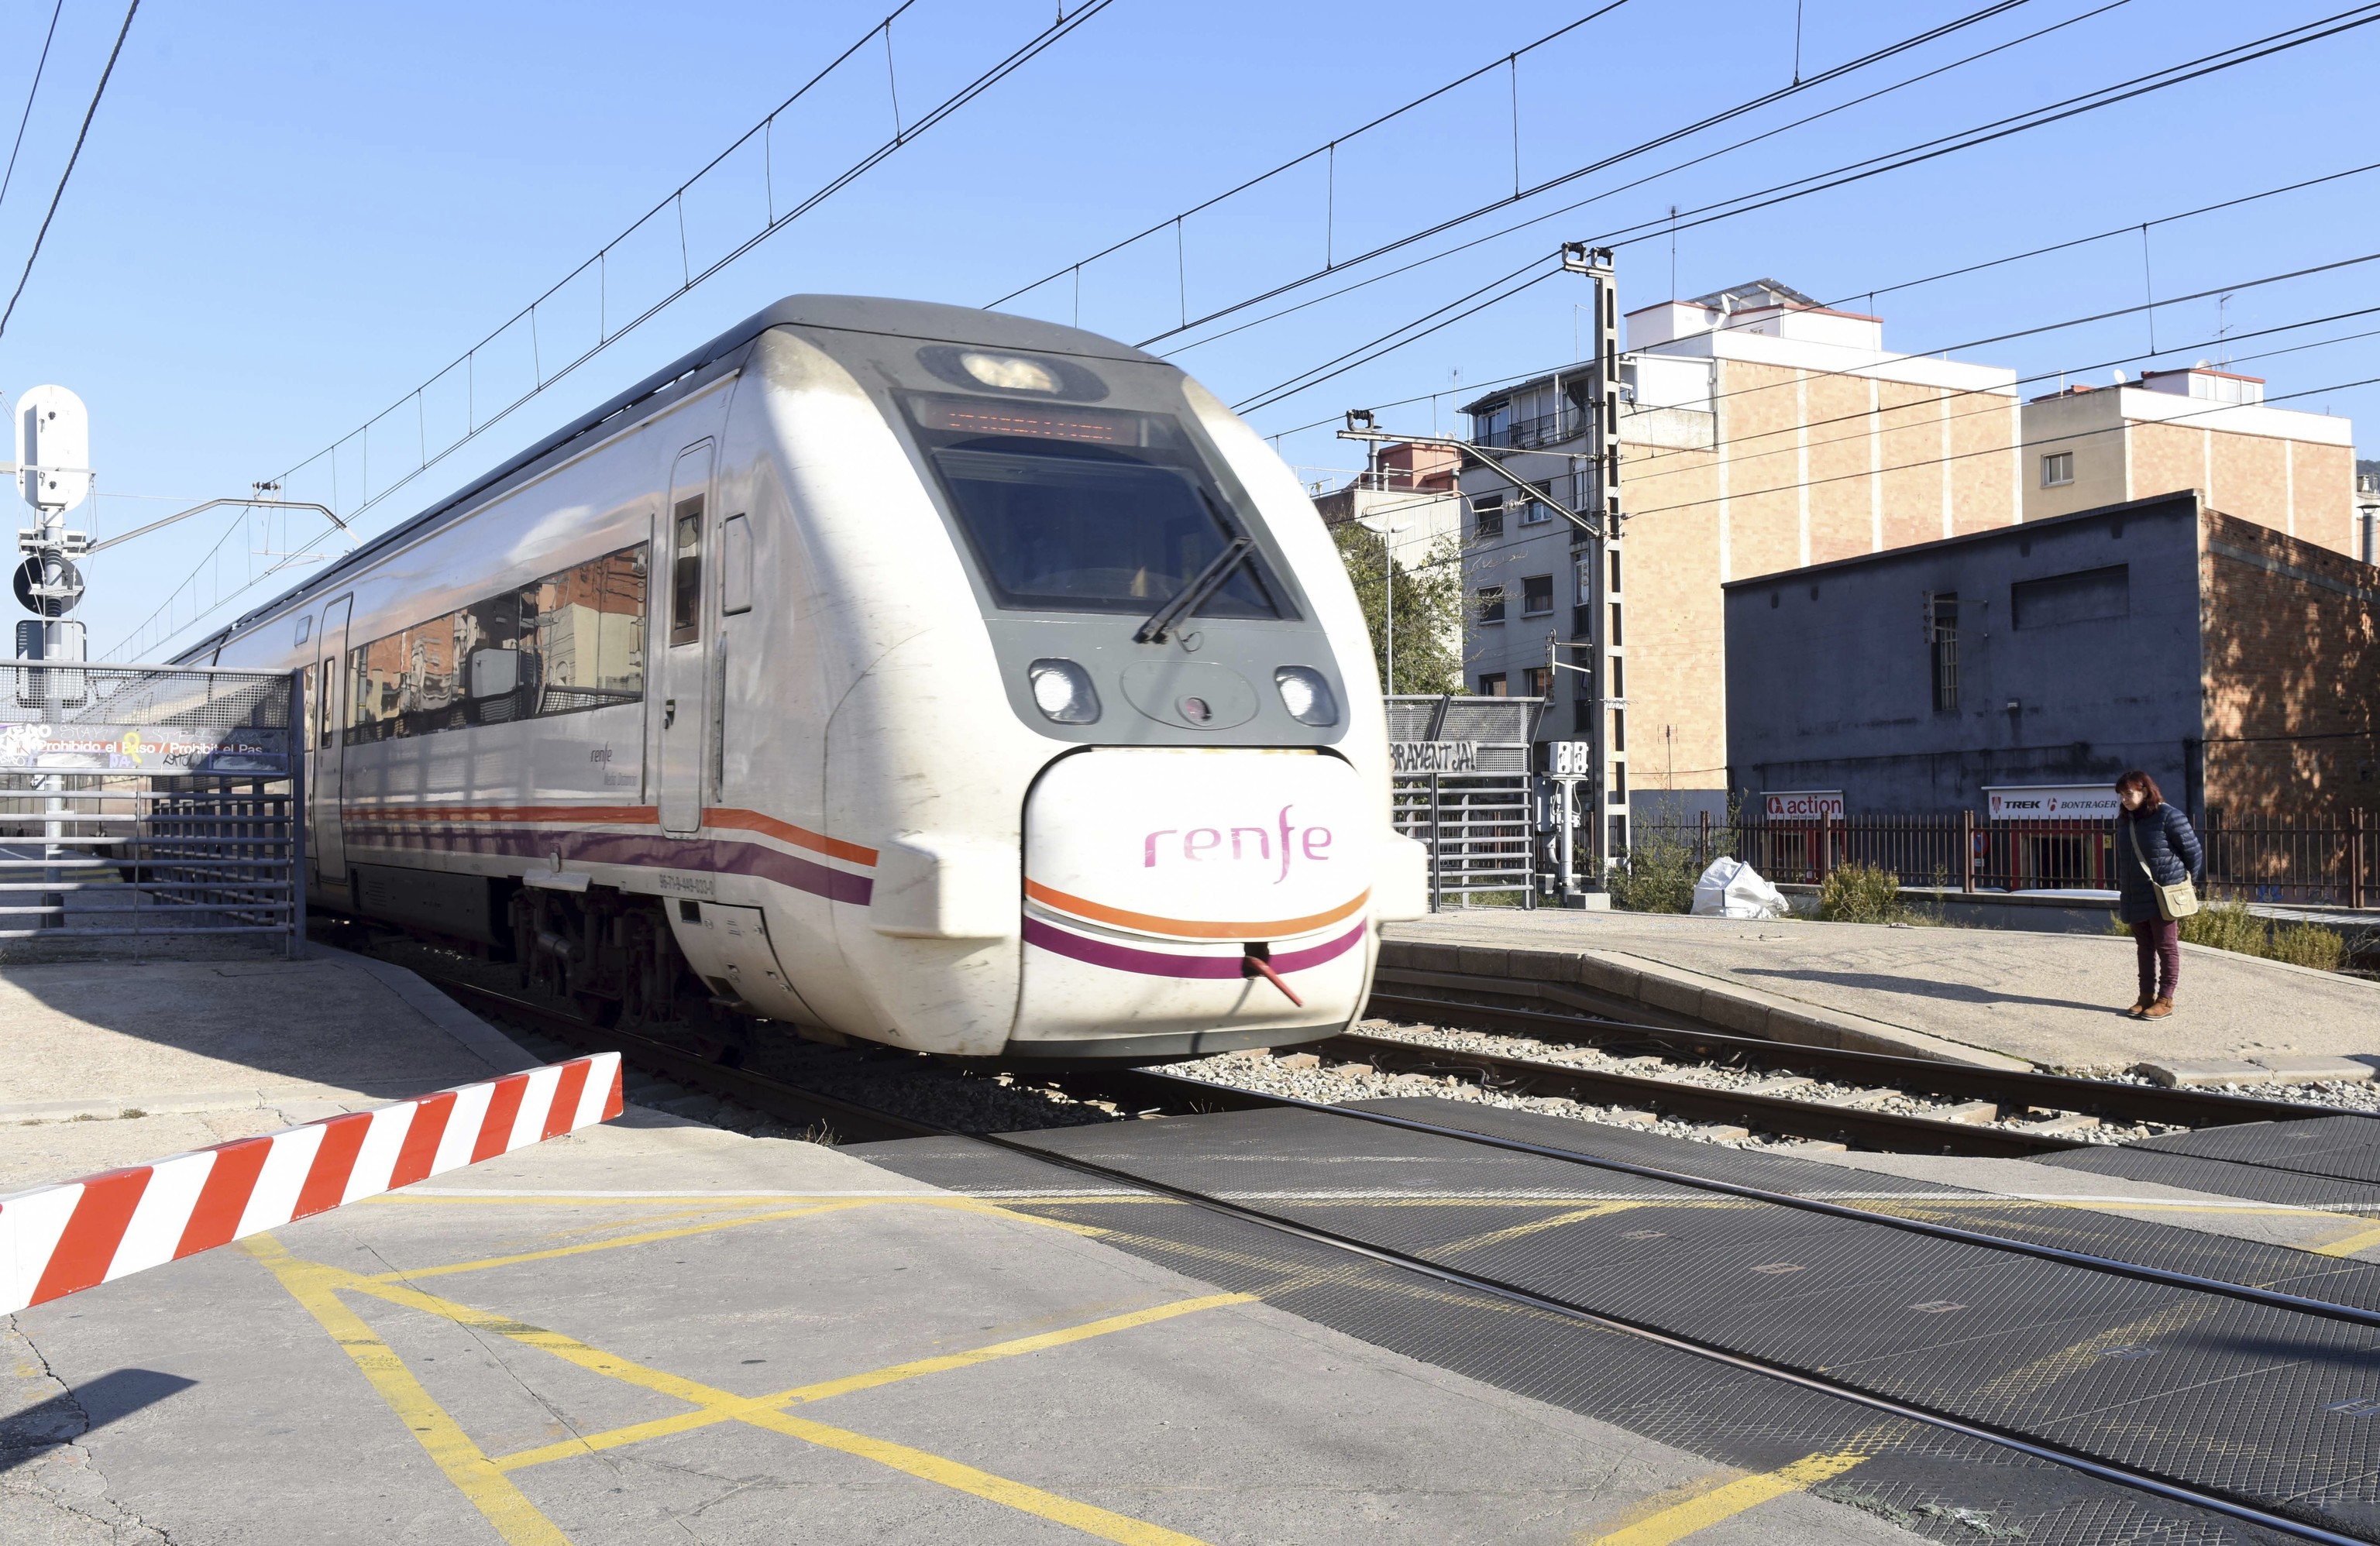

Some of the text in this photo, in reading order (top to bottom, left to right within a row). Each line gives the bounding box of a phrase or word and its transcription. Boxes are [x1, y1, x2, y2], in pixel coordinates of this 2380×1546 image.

[39, 740, 101, 753] Prohibido
[105, 741, 116, 753] el
[159, 743, 166, 754] /
[170, 743, 218, 754] Prohibit
[223, 744, 234, 754] el
[239, 744, 263, 754] Pas
[590, 740, 612, 770] renfe
[1787, 795, 1842, 814] action
[2061, 800, 2117, 809] BONTRAGER
[1144, 804, 1332, 885] renfe
